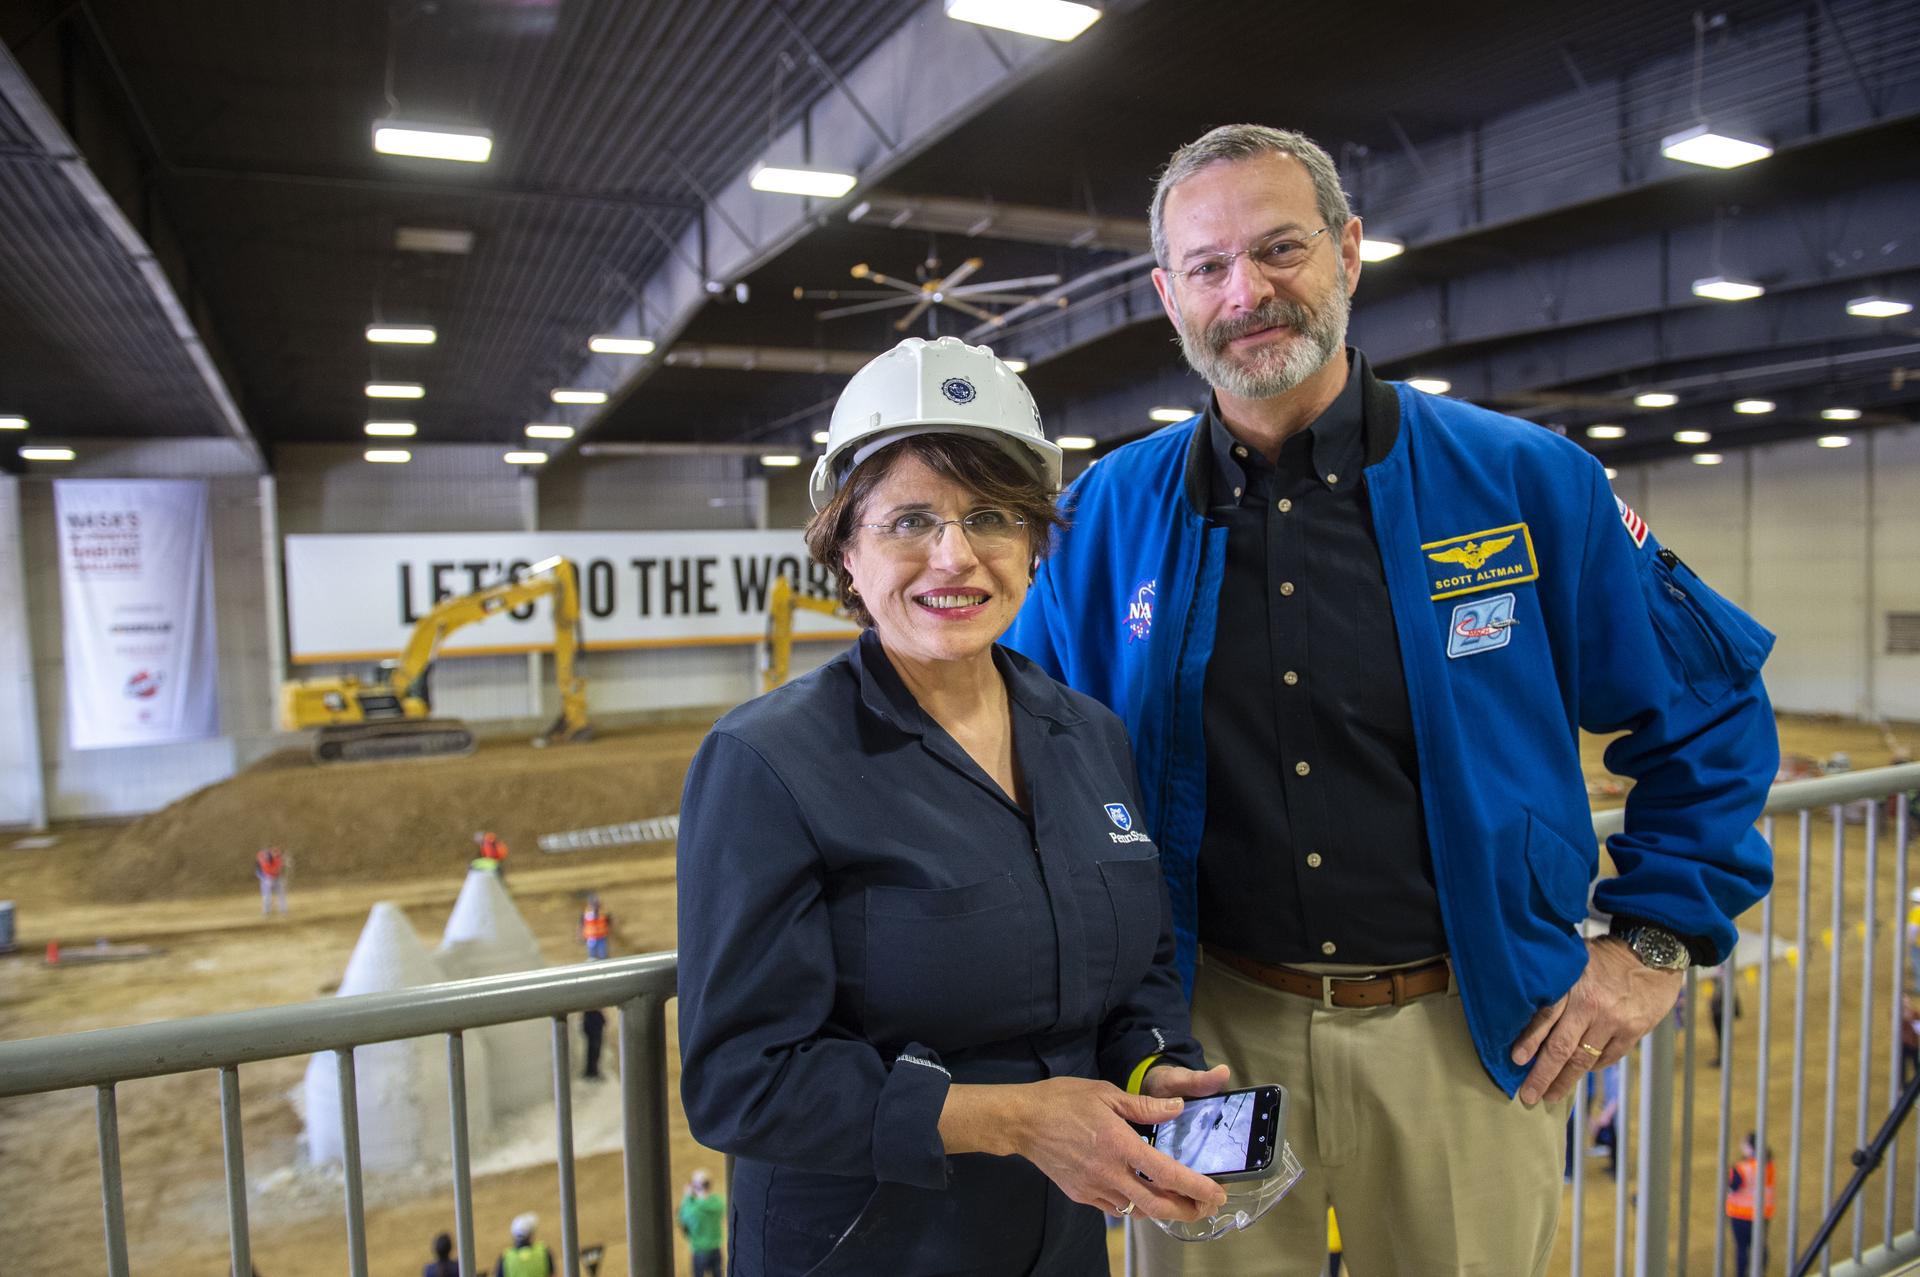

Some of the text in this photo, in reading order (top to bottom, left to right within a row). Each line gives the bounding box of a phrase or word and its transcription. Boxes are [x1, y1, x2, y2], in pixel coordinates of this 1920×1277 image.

[632, 557, 718, 616] THE
[733, 555, 841, 614] WOR
[1435, 563, 1524, 590] SCOTT ALTMAN
